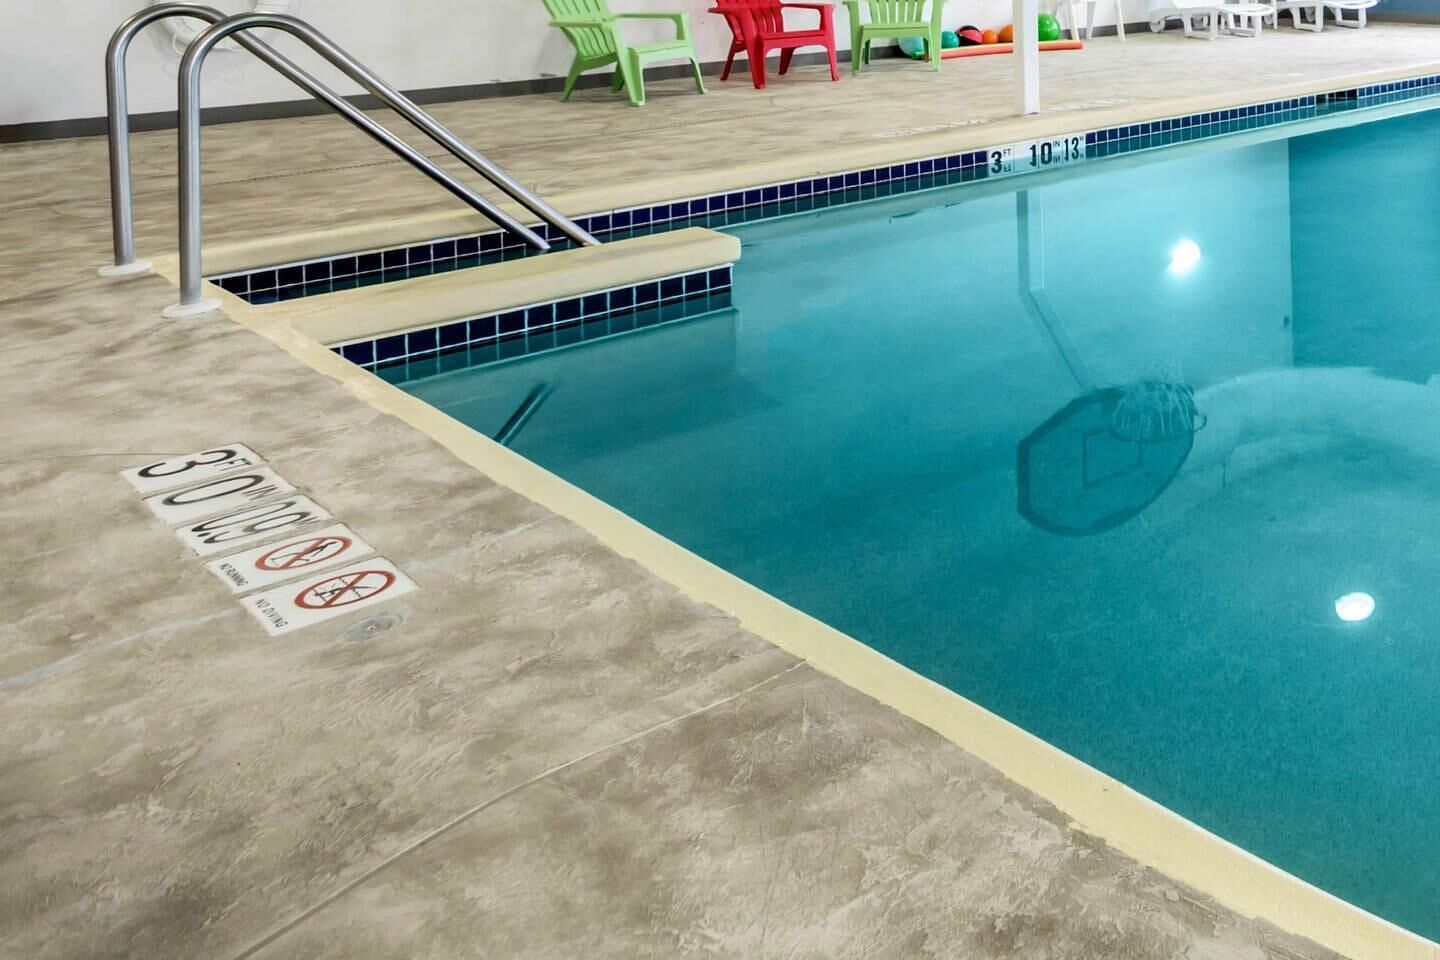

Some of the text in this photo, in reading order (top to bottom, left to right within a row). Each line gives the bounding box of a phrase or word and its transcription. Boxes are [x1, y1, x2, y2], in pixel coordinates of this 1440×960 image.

[1003, 149, 1011, 157] FT
[138, 449, 237, 478] 3
[213, 457, 252, 471] FT
[161, 474, 265, 506] 0
[242, 484, 282, 501] IN
[255, 598, 289, 628] NO DIVING
